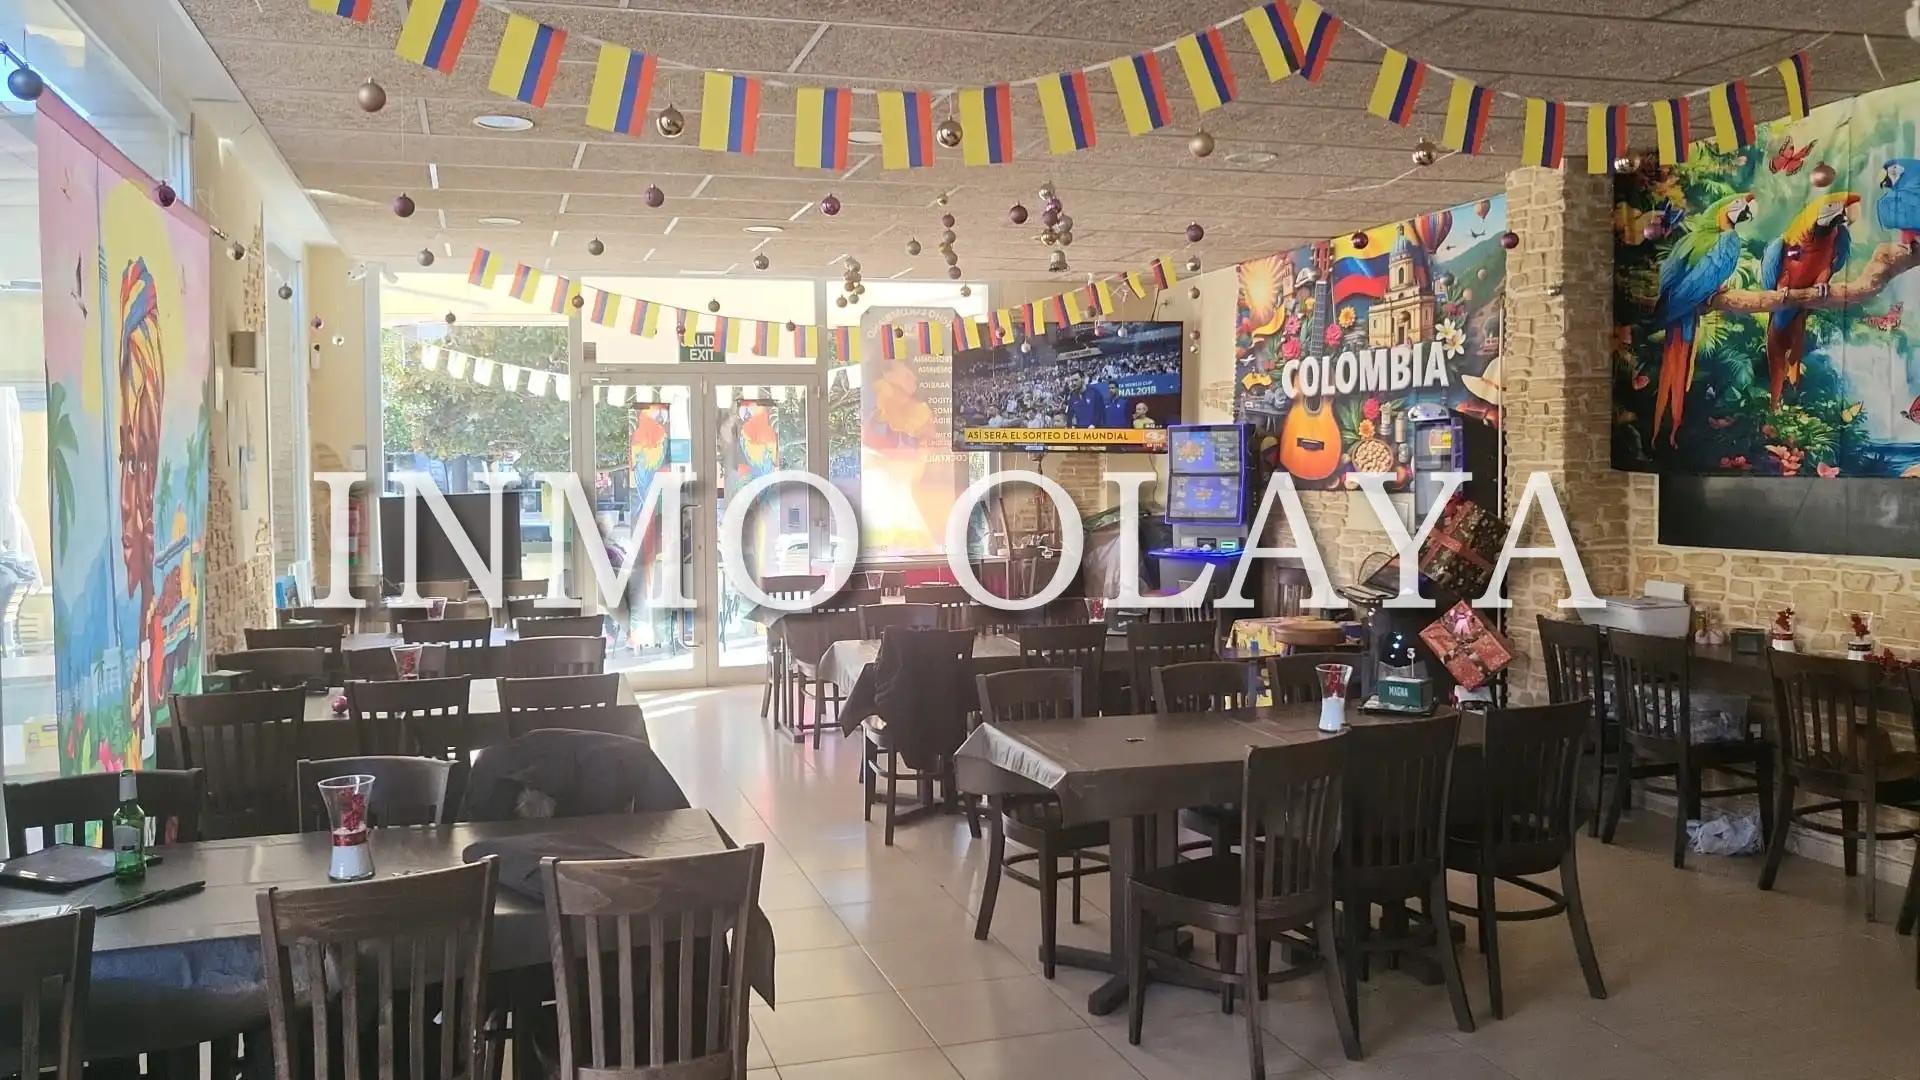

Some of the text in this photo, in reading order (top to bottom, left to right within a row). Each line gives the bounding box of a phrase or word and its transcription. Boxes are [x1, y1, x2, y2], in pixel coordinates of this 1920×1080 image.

[695, 335, 715, 348] LID
[689, 348, 714, 361] EXIT
[1281, 341, 1449, 399] COLOMBIA
[1118, 385, 1157, 397] NAL 2018
[1010, 431, 1021, 440] EL
[1022, 431, 1061, 440] SORTEO
[1063, 431, 1081, 440] DEL
[1083, 431, 1129, 440] MUNDIAL
